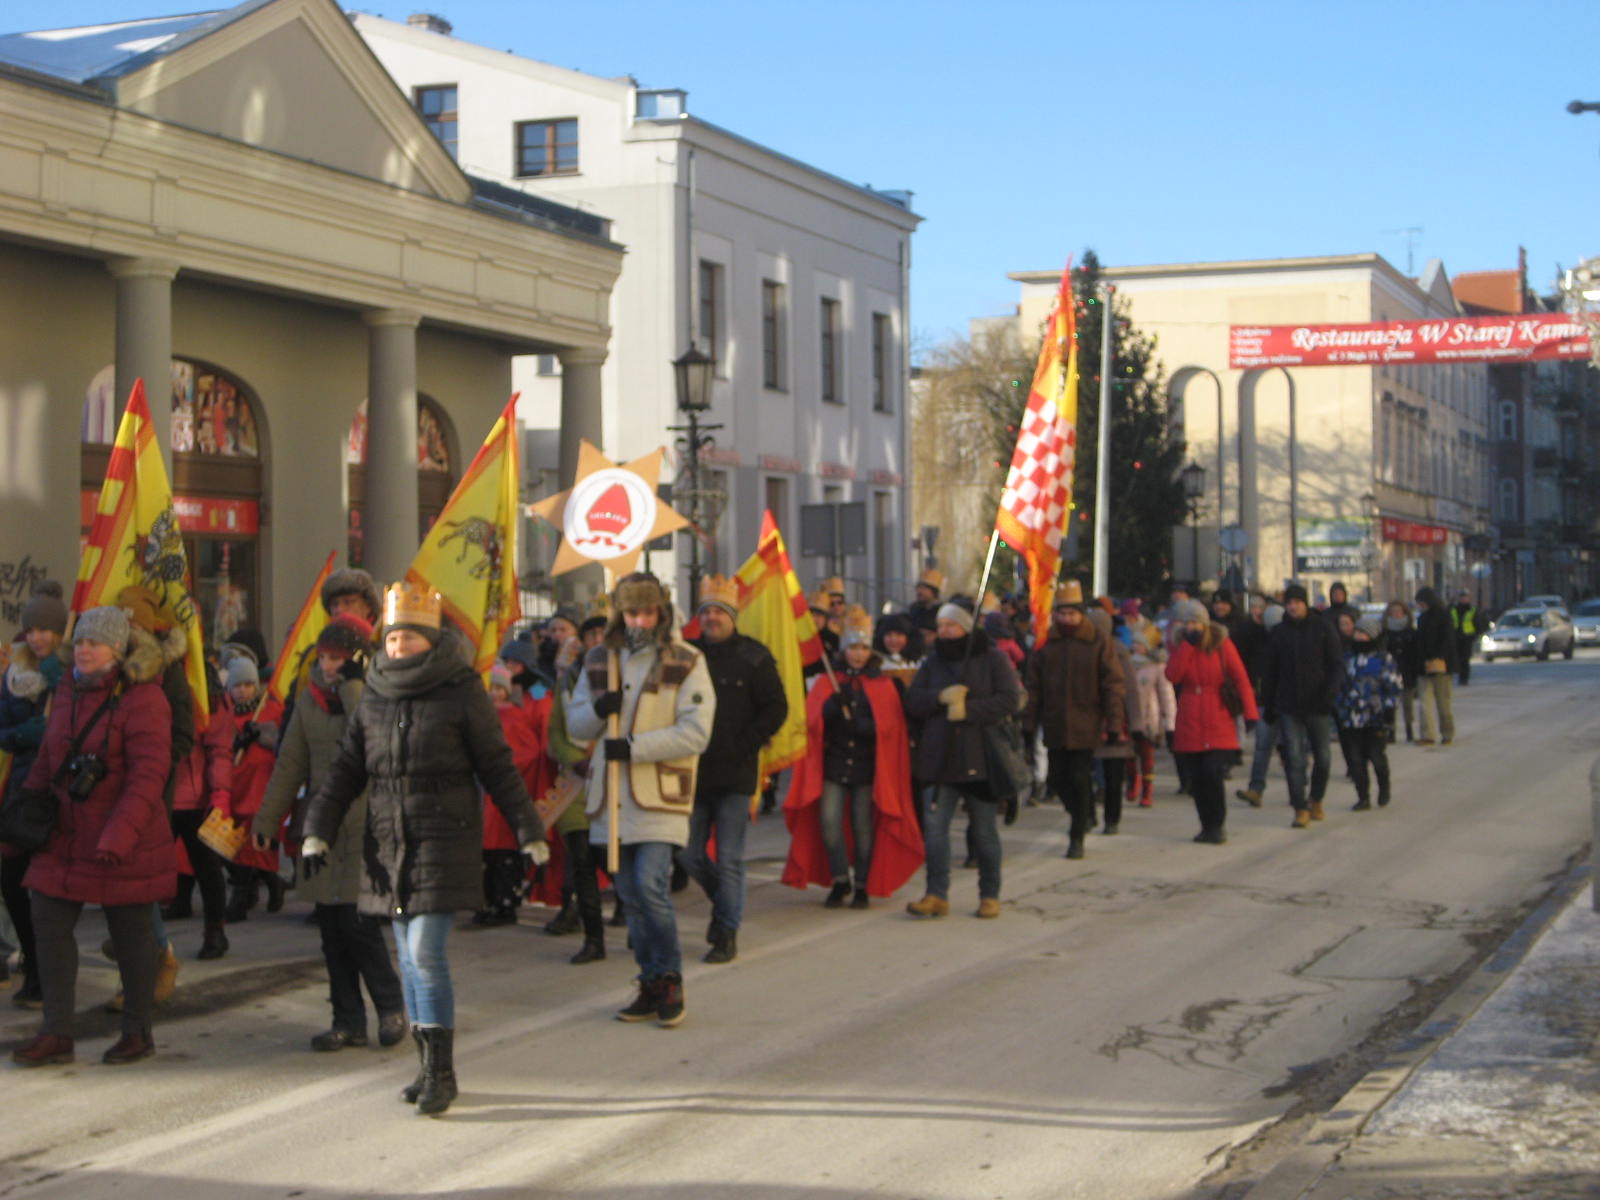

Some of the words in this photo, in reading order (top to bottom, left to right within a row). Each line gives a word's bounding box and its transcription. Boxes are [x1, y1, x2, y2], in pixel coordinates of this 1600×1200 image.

[1291, 325, 1413, 350] Restauracja
[1417, 321, 1450, 344] W
[1448, 320, 1516, 347] Starej
